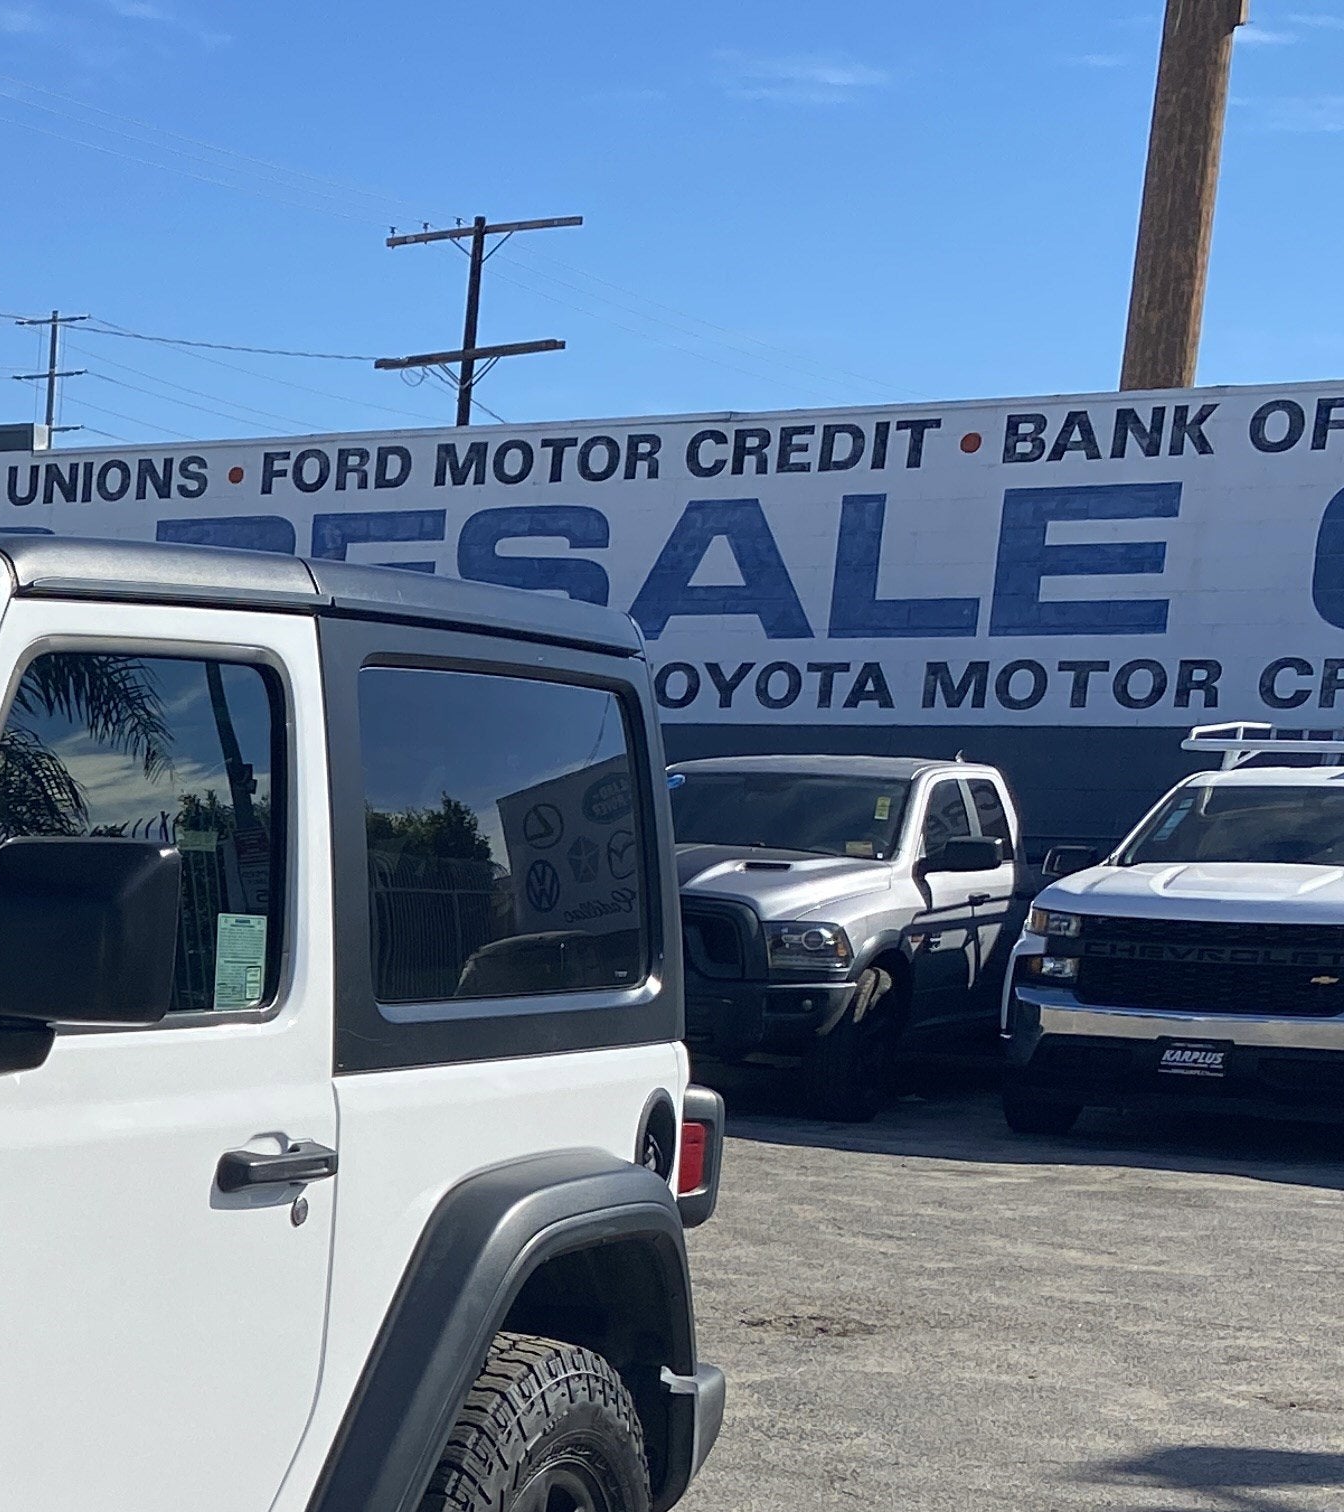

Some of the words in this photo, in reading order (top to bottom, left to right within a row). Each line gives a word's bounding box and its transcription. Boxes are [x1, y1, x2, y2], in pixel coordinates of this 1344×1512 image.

[6, 454, 210, 508] UNIONS
[259, 446, 413, 496] FORD
[433, 434, 661, 487] MOTOR
[684, 418, 942, 477] CREDIT
[1001, 402, 1221, 464] BANK
[649, 660, 895, 710] OYOTA
[921, 658, 1223, 709] MOTOR
[1161, 1049, 1225, 1064] KARPLUS
